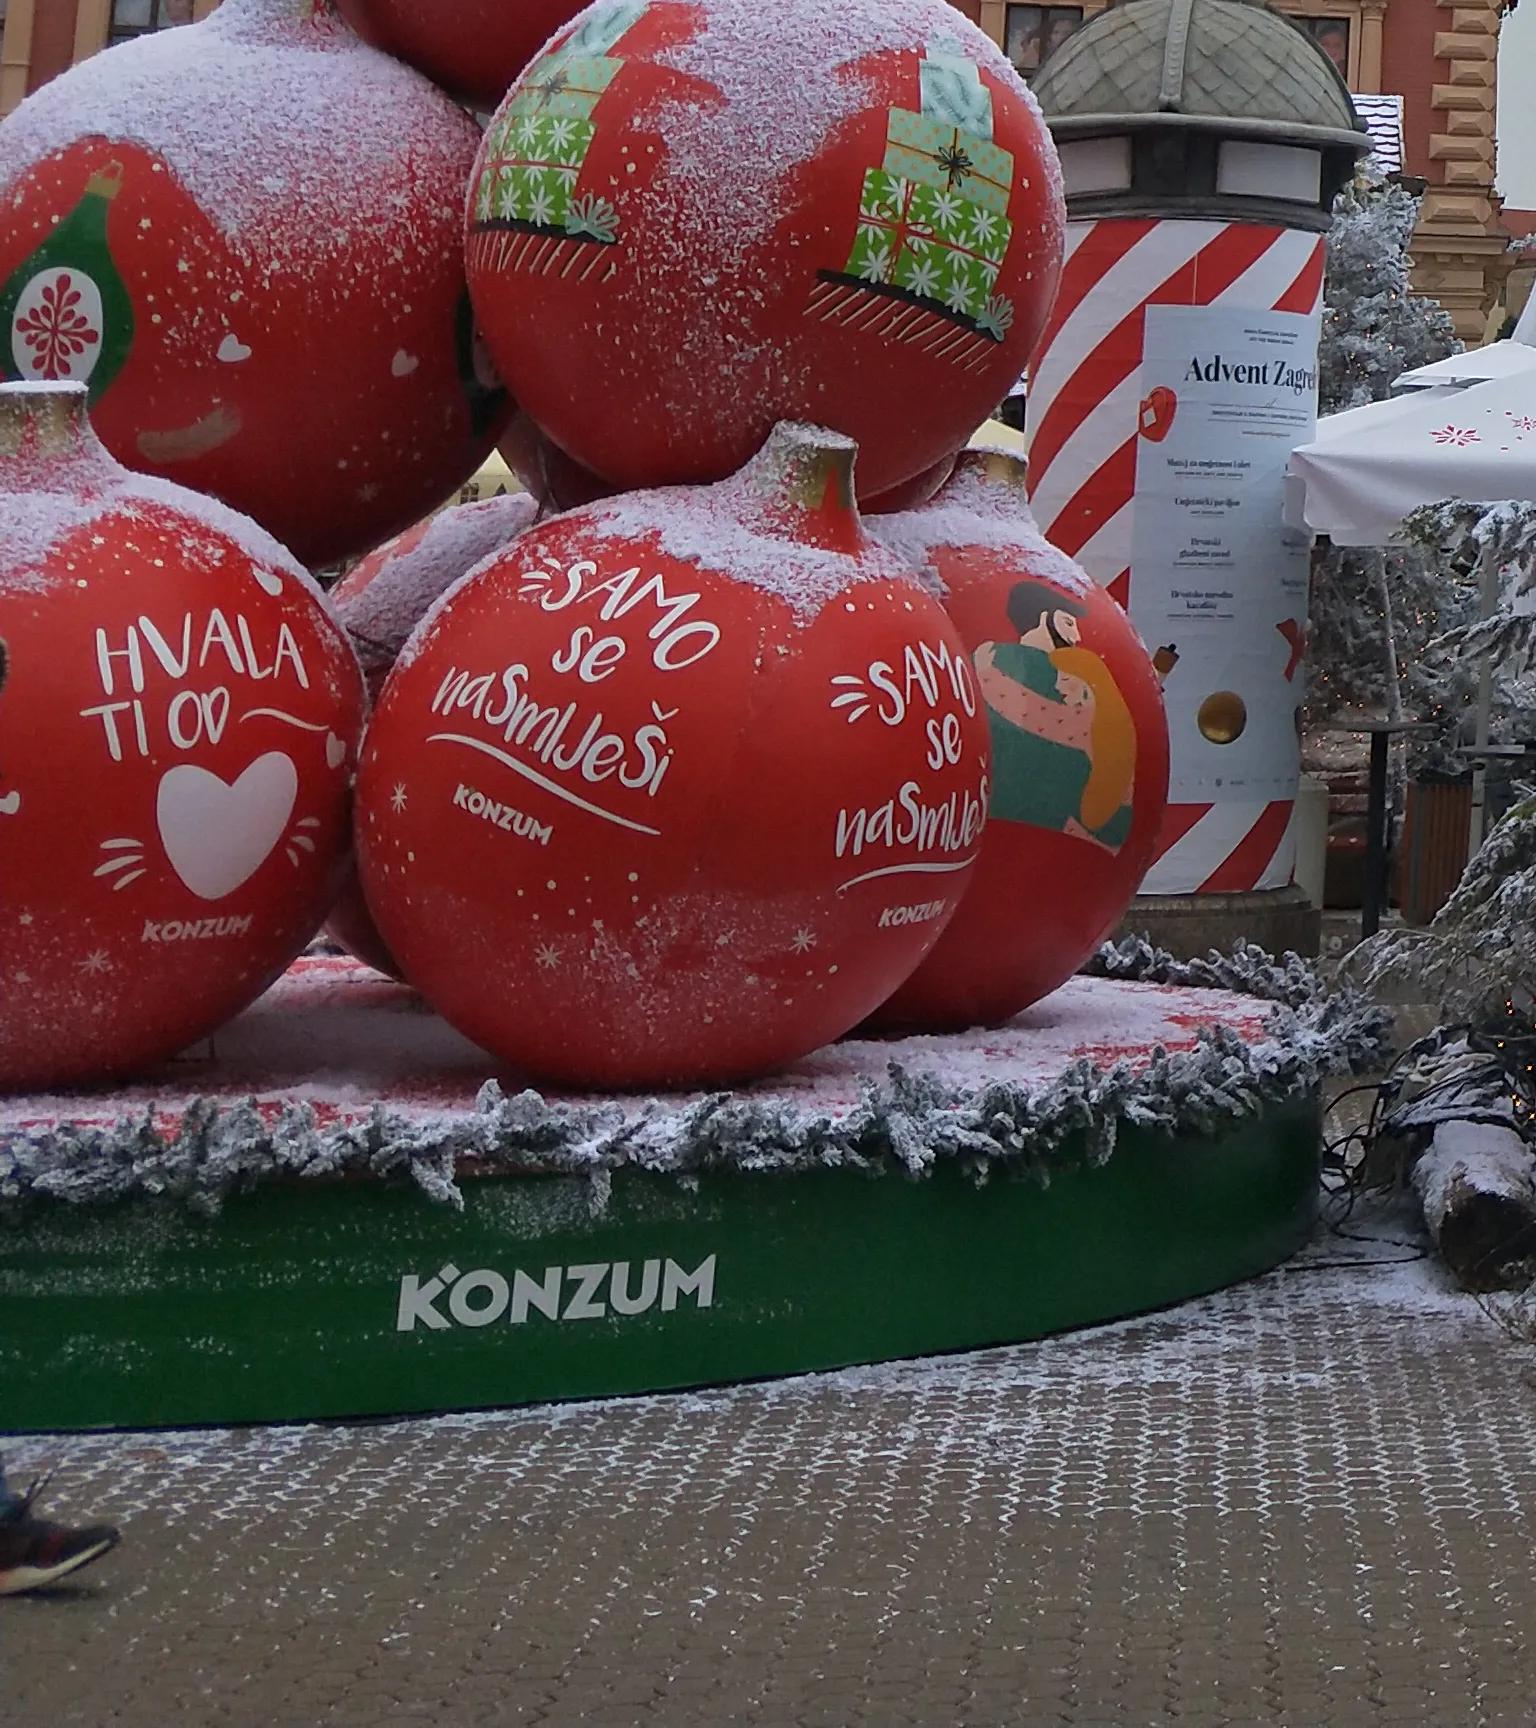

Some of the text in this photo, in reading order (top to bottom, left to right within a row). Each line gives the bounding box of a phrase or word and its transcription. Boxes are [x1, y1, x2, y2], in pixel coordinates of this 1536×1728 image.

[1184, 355, 1269, 385] Advent
[541, 559, 721, 671] SAMO
[96, 608, 309, 696] HVALA
[868, 640, 975, 725] SAMO
[79, 699, 150, 761] TI
[454, 783, 553, 846] KONZUM
[141, 914, 252, 943] KONZUM
[879, 899, 945, 928] KONZUM
[396, 1253, 717, 1332] KONZUM
